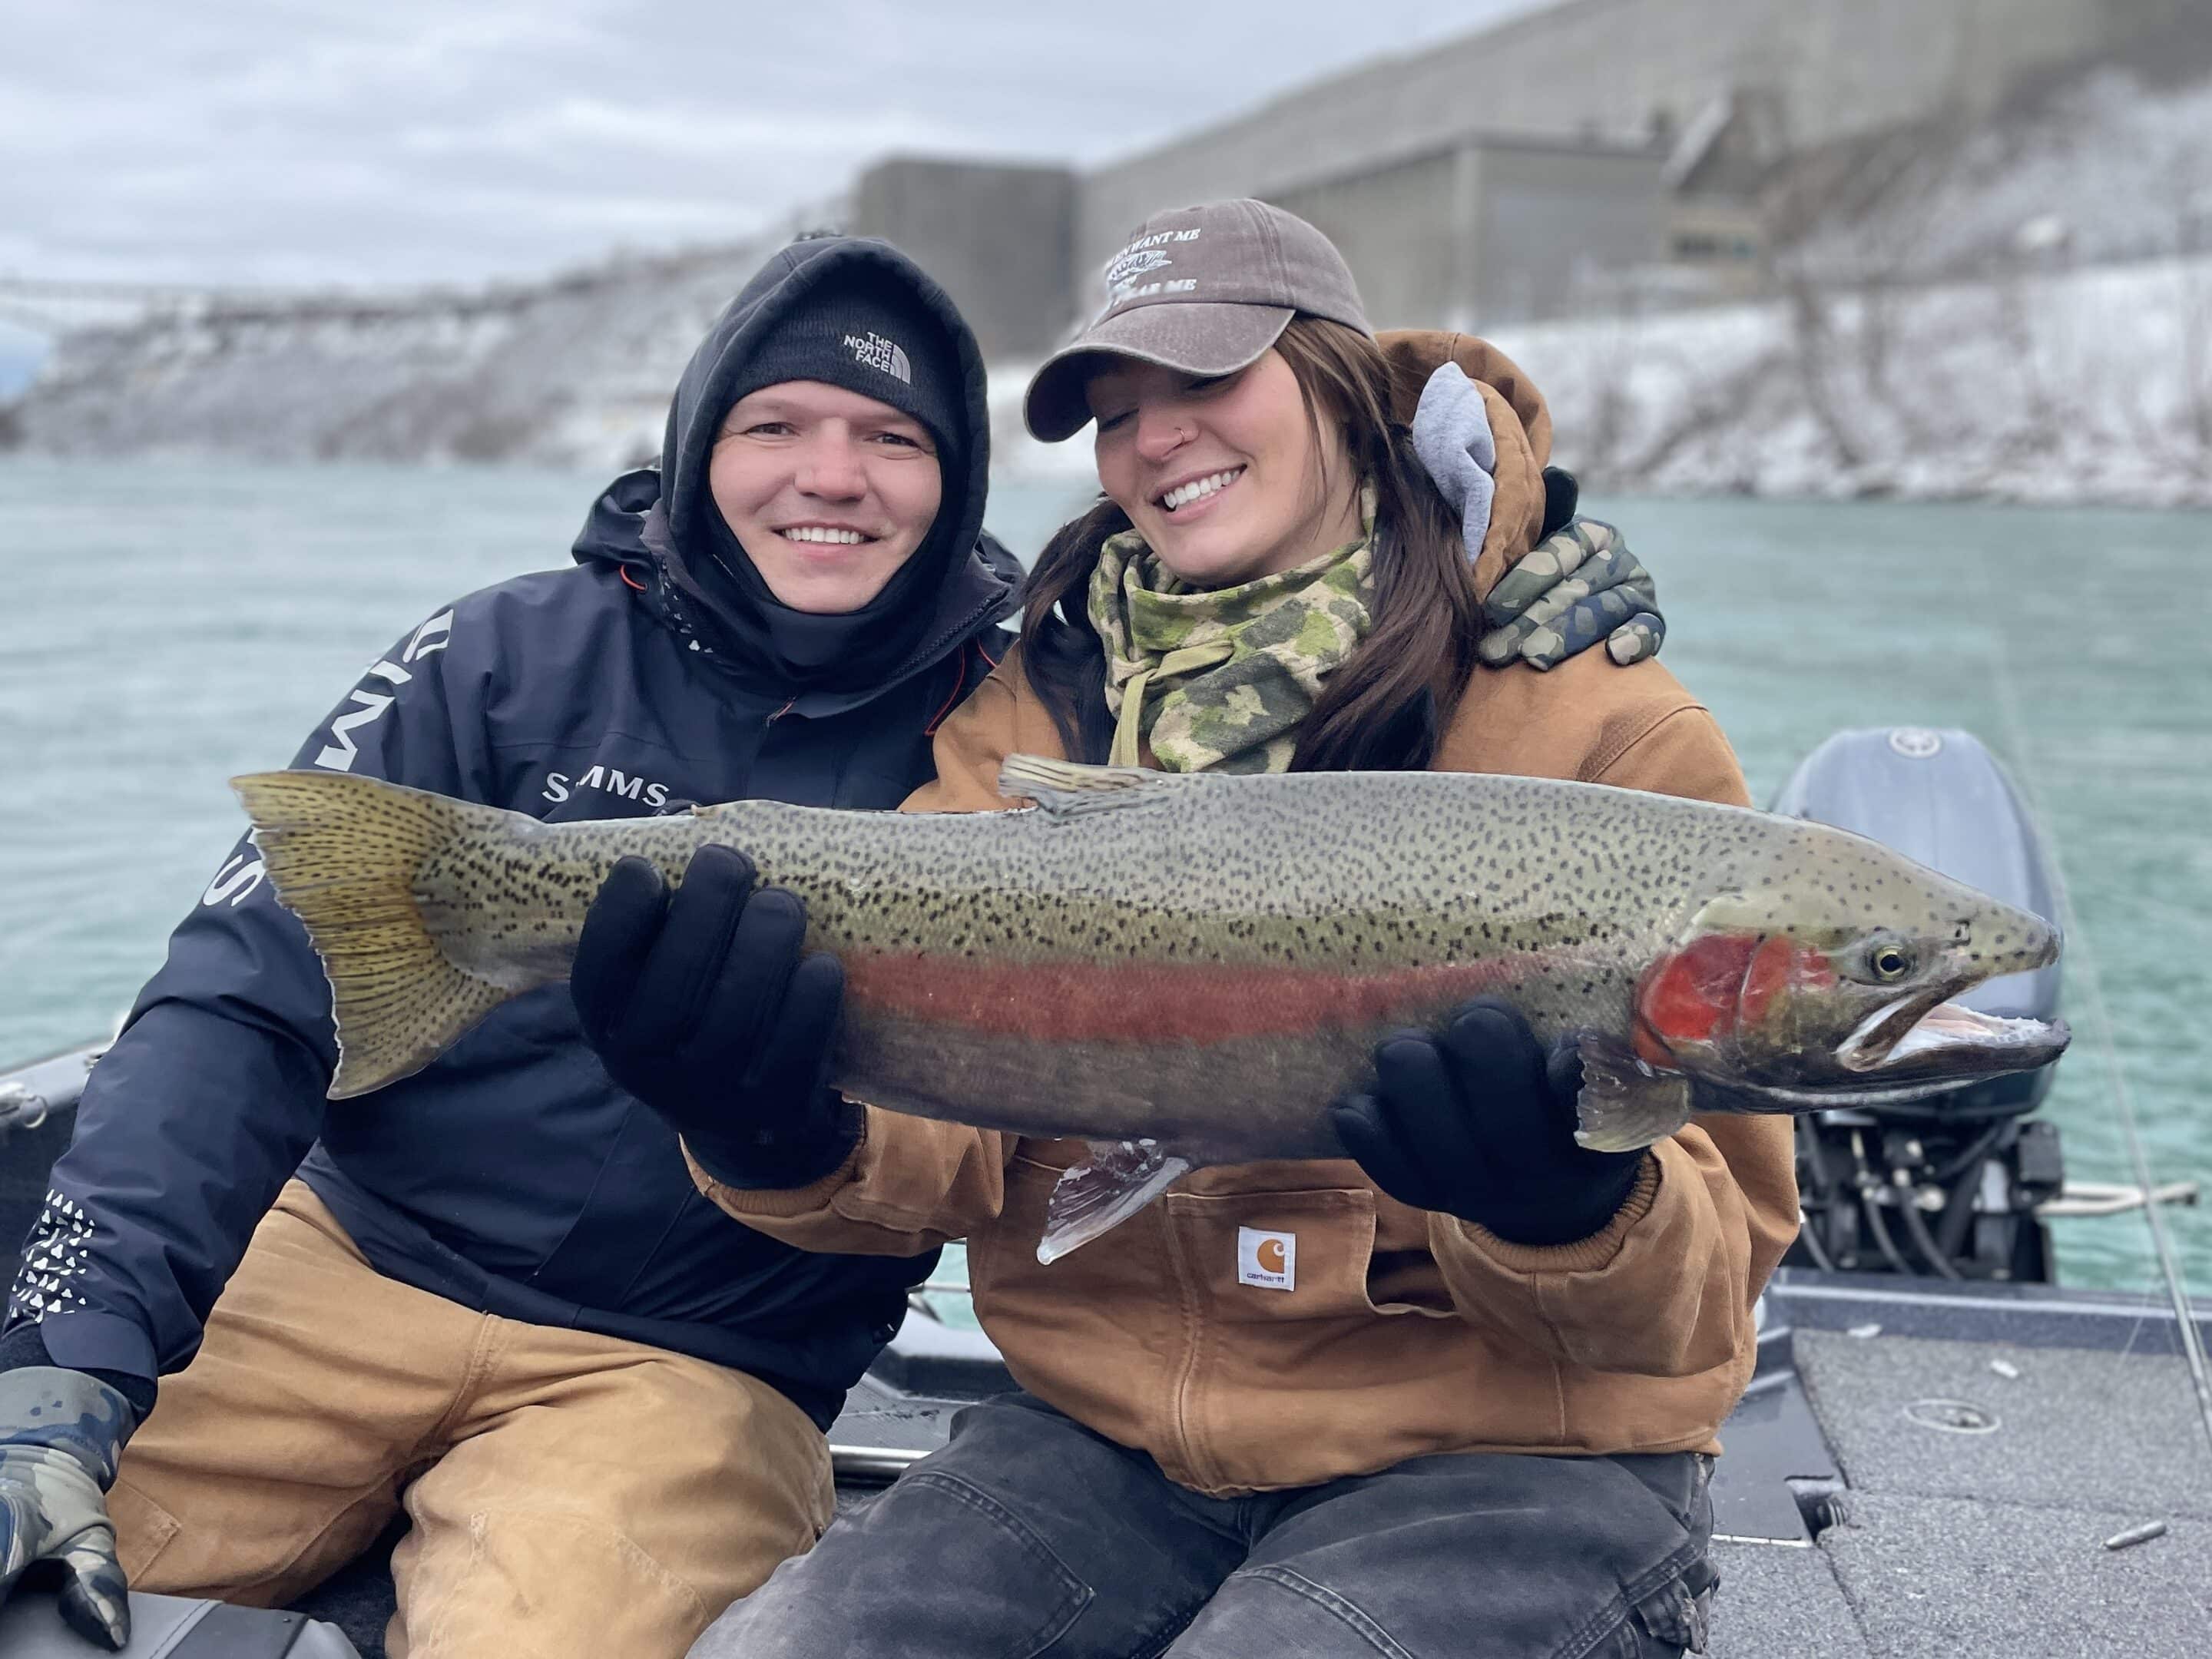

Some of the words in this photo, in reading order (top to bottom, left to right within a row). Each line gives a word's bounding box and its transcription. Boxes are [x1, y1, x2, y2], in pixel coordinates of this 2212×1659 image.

[1129, 230, 1174, 253] WANT
[1174, 228, 1200, 241] ME
[844, 335, 891, 361] NORTH
[867, 332, 892, 349] THE
[856, 350, 889, 373] FACE
[203, 608, 454, 907] SIMS
[1247, 1273, 1284, 1283] carhartt
